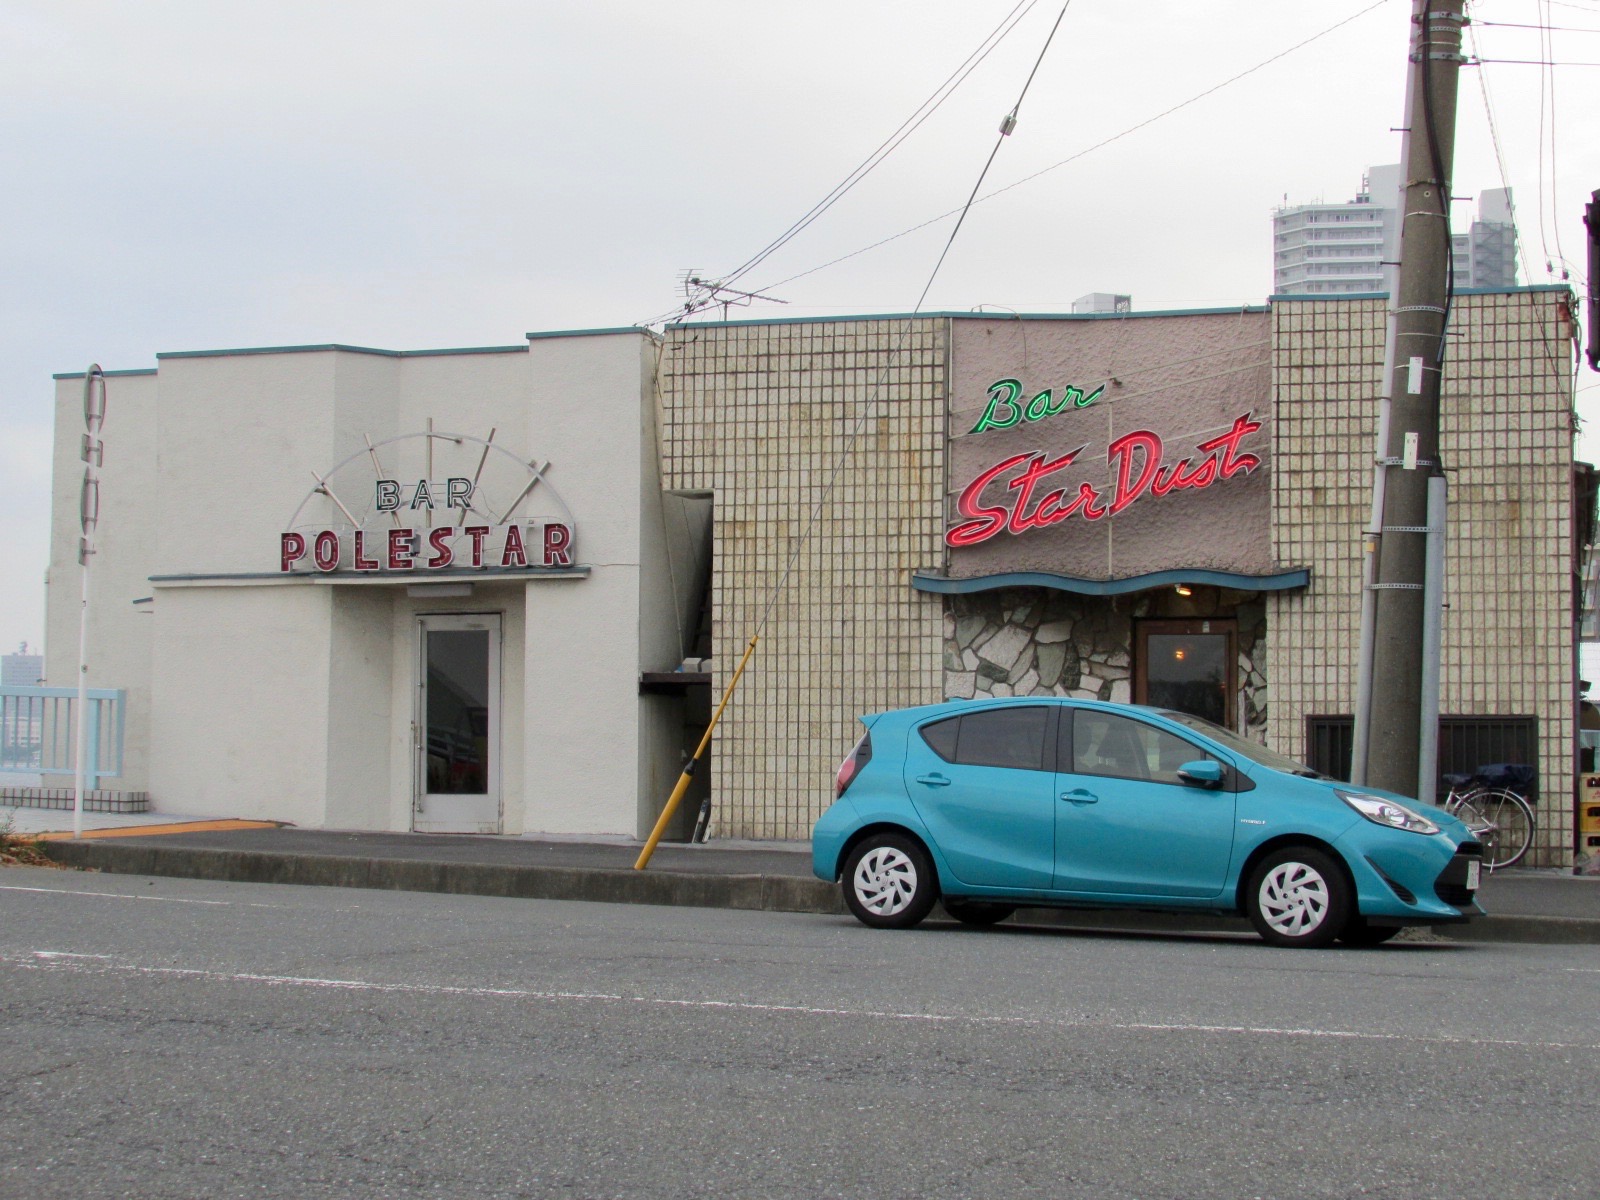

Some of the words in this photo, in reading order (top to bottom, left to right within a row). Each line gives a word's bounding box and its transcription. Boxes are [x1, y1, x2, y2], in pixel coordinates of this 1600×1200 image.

[968, 378, 1105, 433] Bar
[376, 478, 473, 512] BAR
[281, 523, 571, 572] POLESTAR
